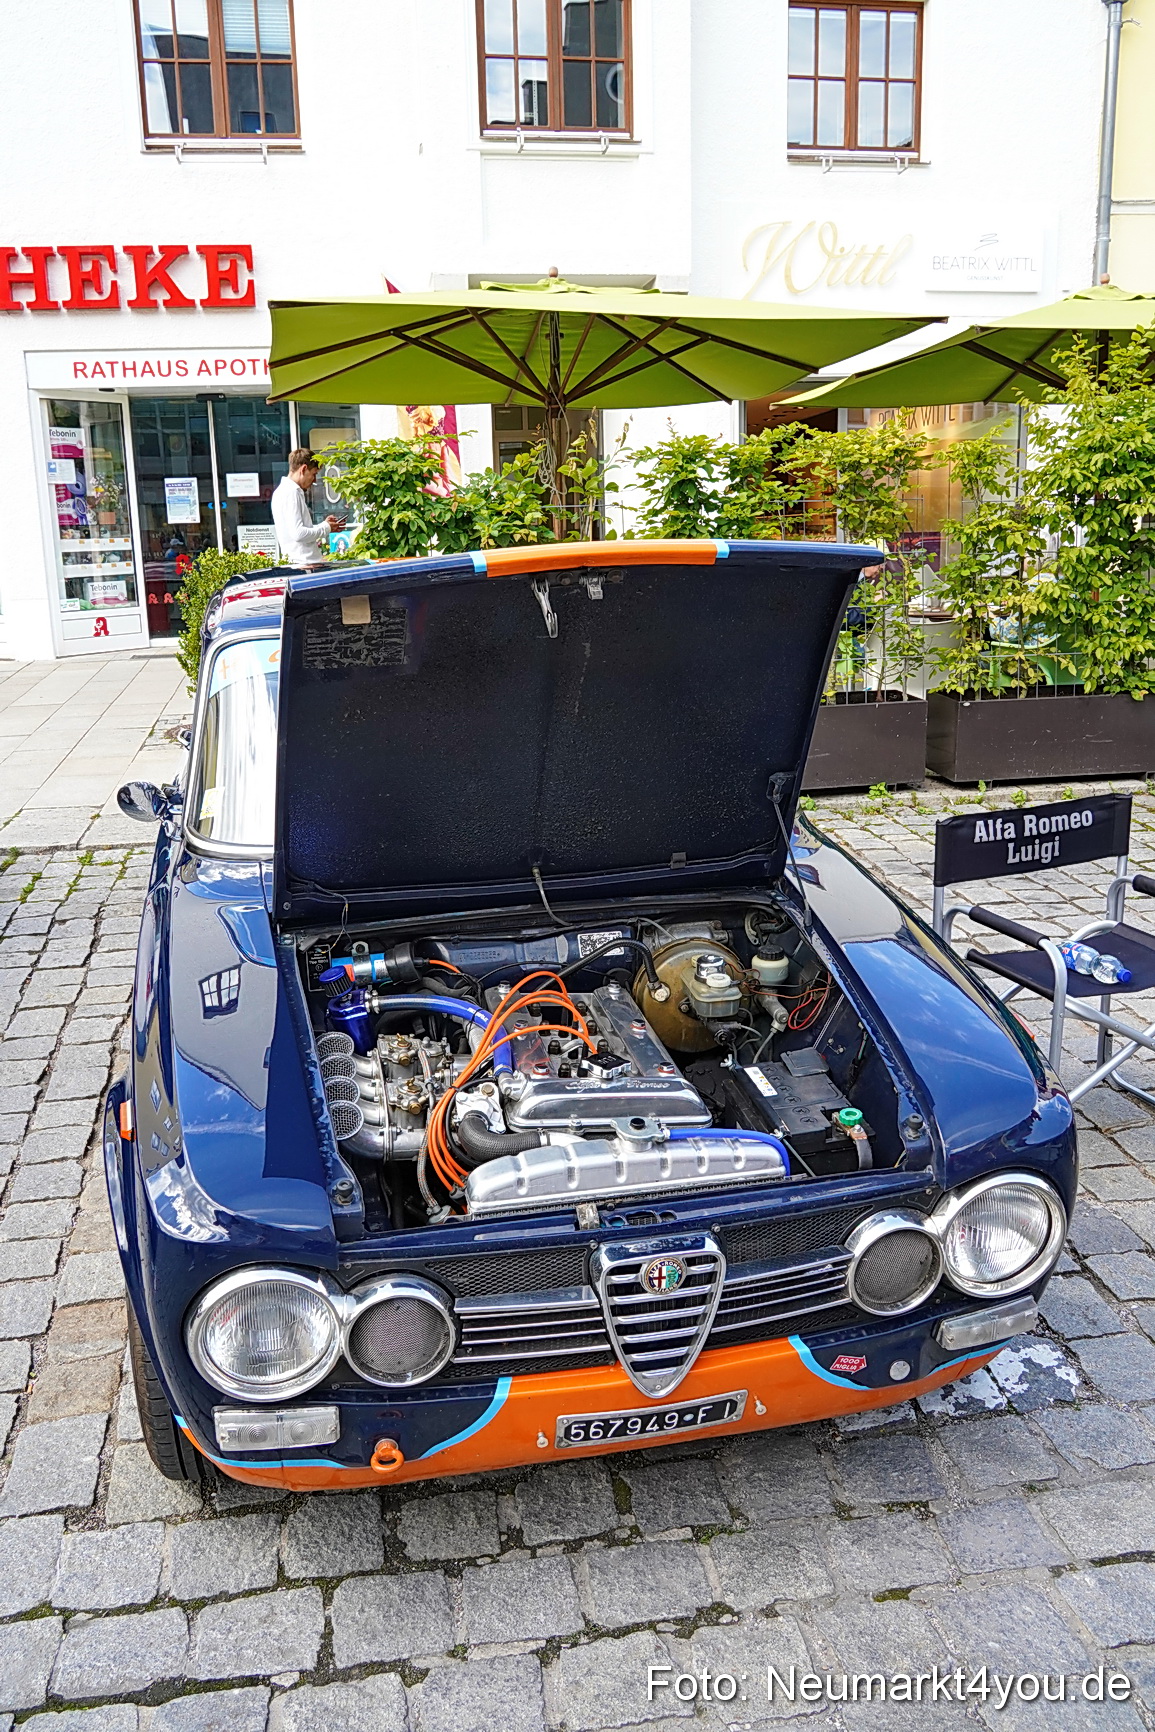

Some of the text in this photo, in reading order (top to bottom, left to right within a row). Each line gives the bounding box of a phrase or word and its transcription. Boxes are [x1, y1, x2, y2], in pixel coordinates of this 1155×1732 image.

[742, 220, 913, 300] Wittl
[932, 255, 1037, 271] BEATRIX WITTL
[0, 245, 256, 311] HEKE
[73, 360, 189, 378] RATHAUS
[90, 583, 118, 592] Tebonin
[974, 809, 1093, 843] Alfa Romeo
[1006, 836, 1060, 864] Luigi
[570, 1412, 679, 1441] 567949
